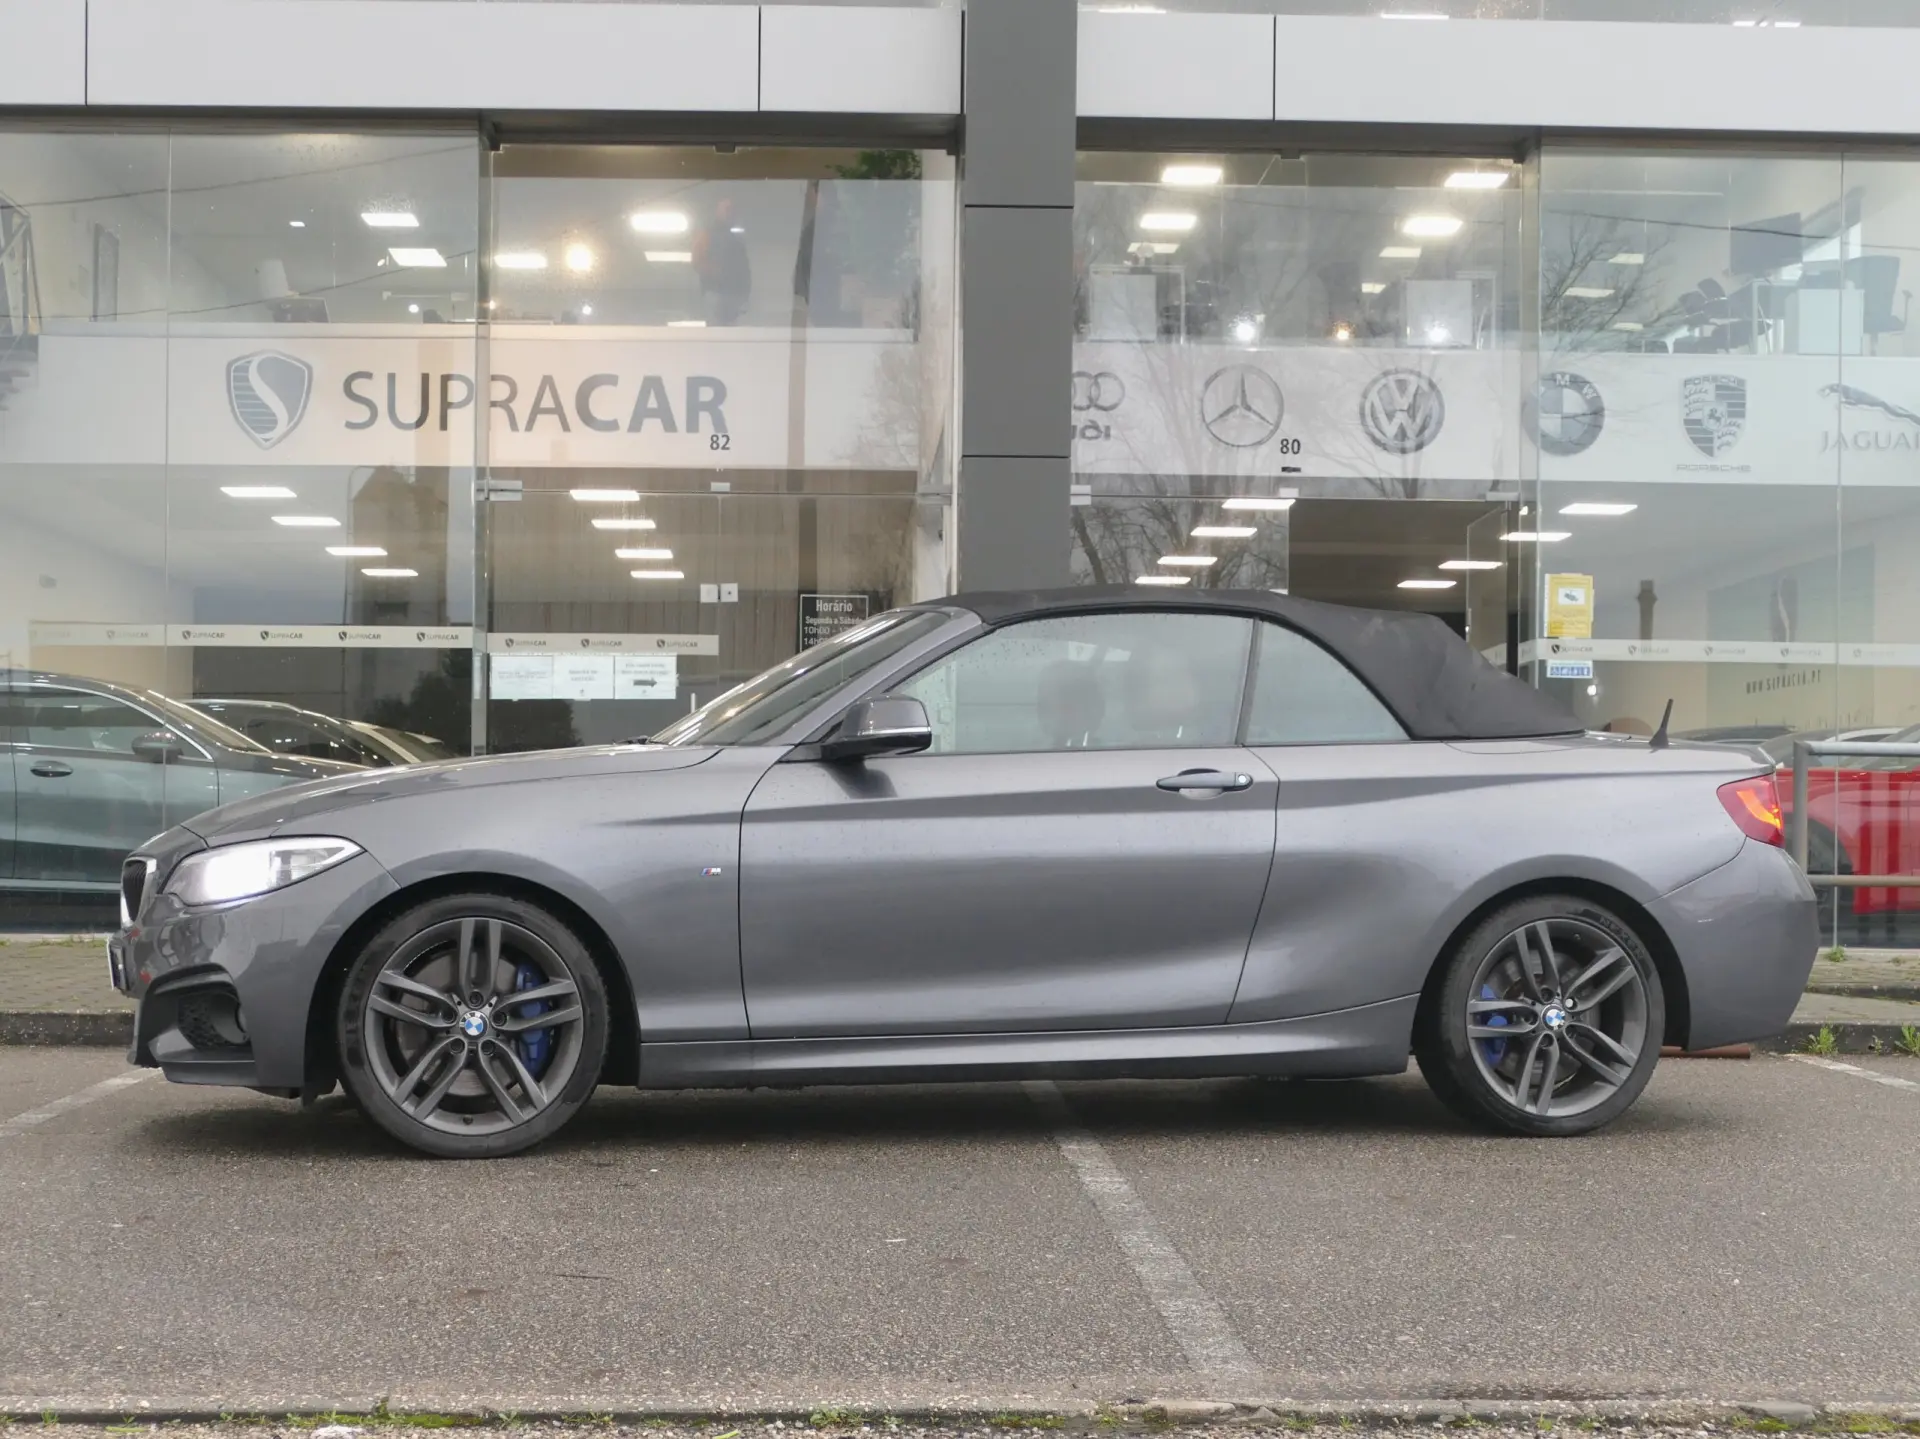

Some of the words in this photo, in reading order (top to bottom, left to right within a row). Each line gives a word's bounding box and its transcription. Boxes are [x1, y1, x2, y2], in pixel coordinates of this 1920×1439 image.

[343, 371, 728, 434] SUPRACAR
[710, 434, 731, 451] 82
[1280, 438, 1301, 455] 80
[1676, 464, 1752, 473] PORSCHE
[815, 600, 853, 612] Horário
[804, 626, 830, 634] 10h00
